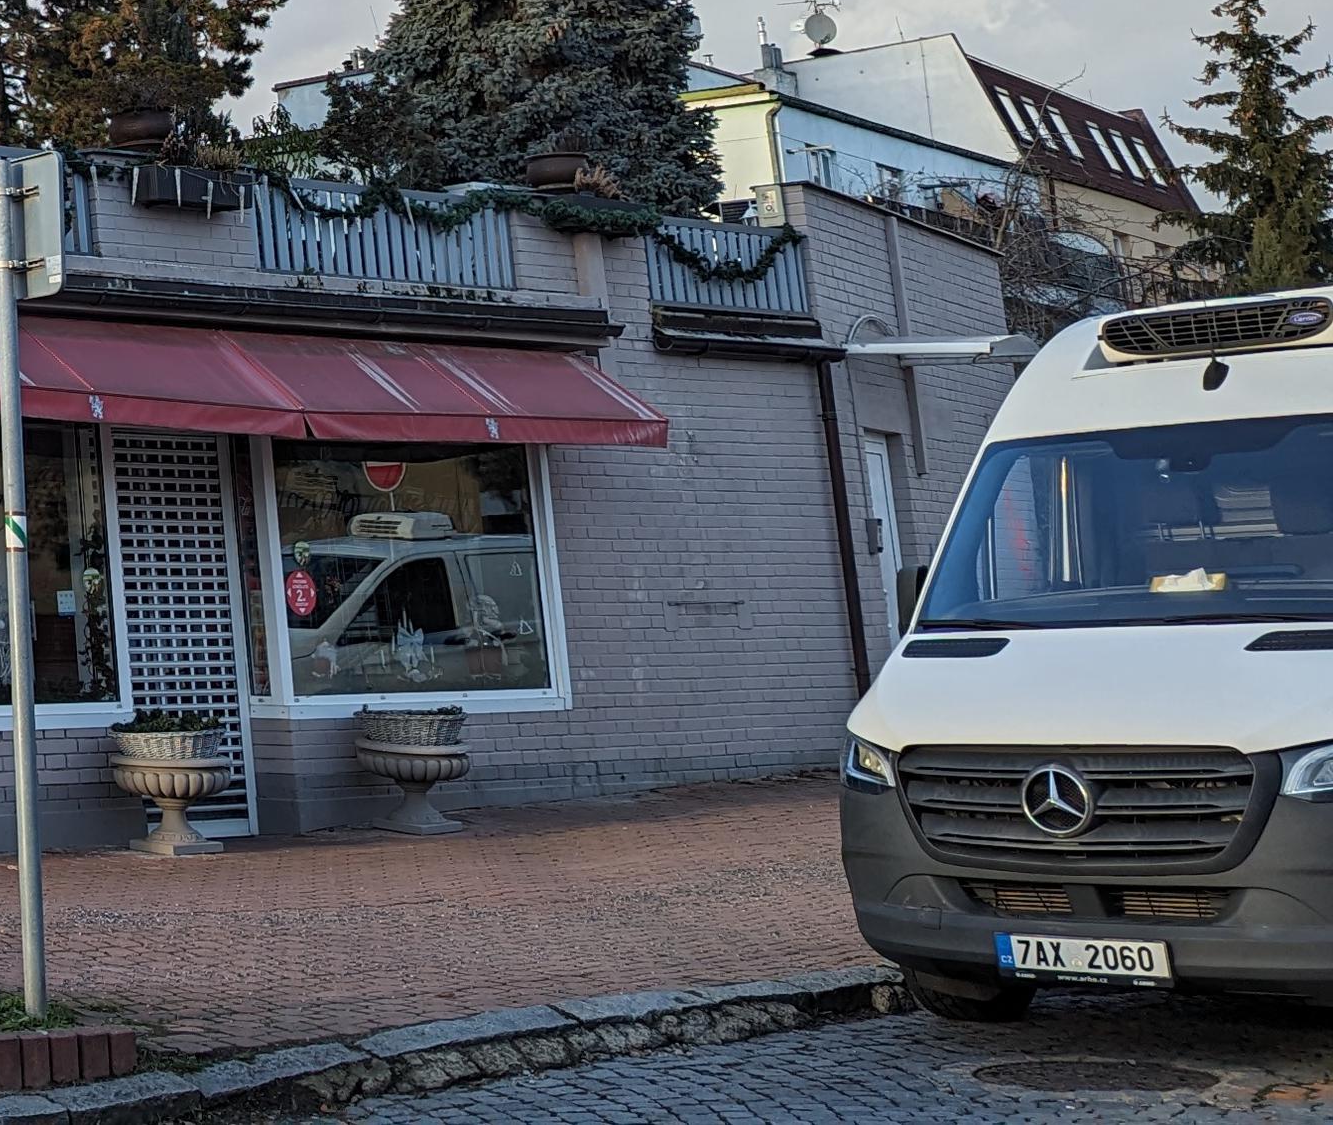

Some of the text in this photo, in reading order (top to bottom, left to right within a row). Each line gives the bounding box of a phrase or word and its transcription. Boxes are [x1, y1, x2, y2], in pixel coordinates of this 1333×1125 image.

[1001, 955, 1013, 963] CZ
[1017, 940, 1154, 972] 7AX 2060
